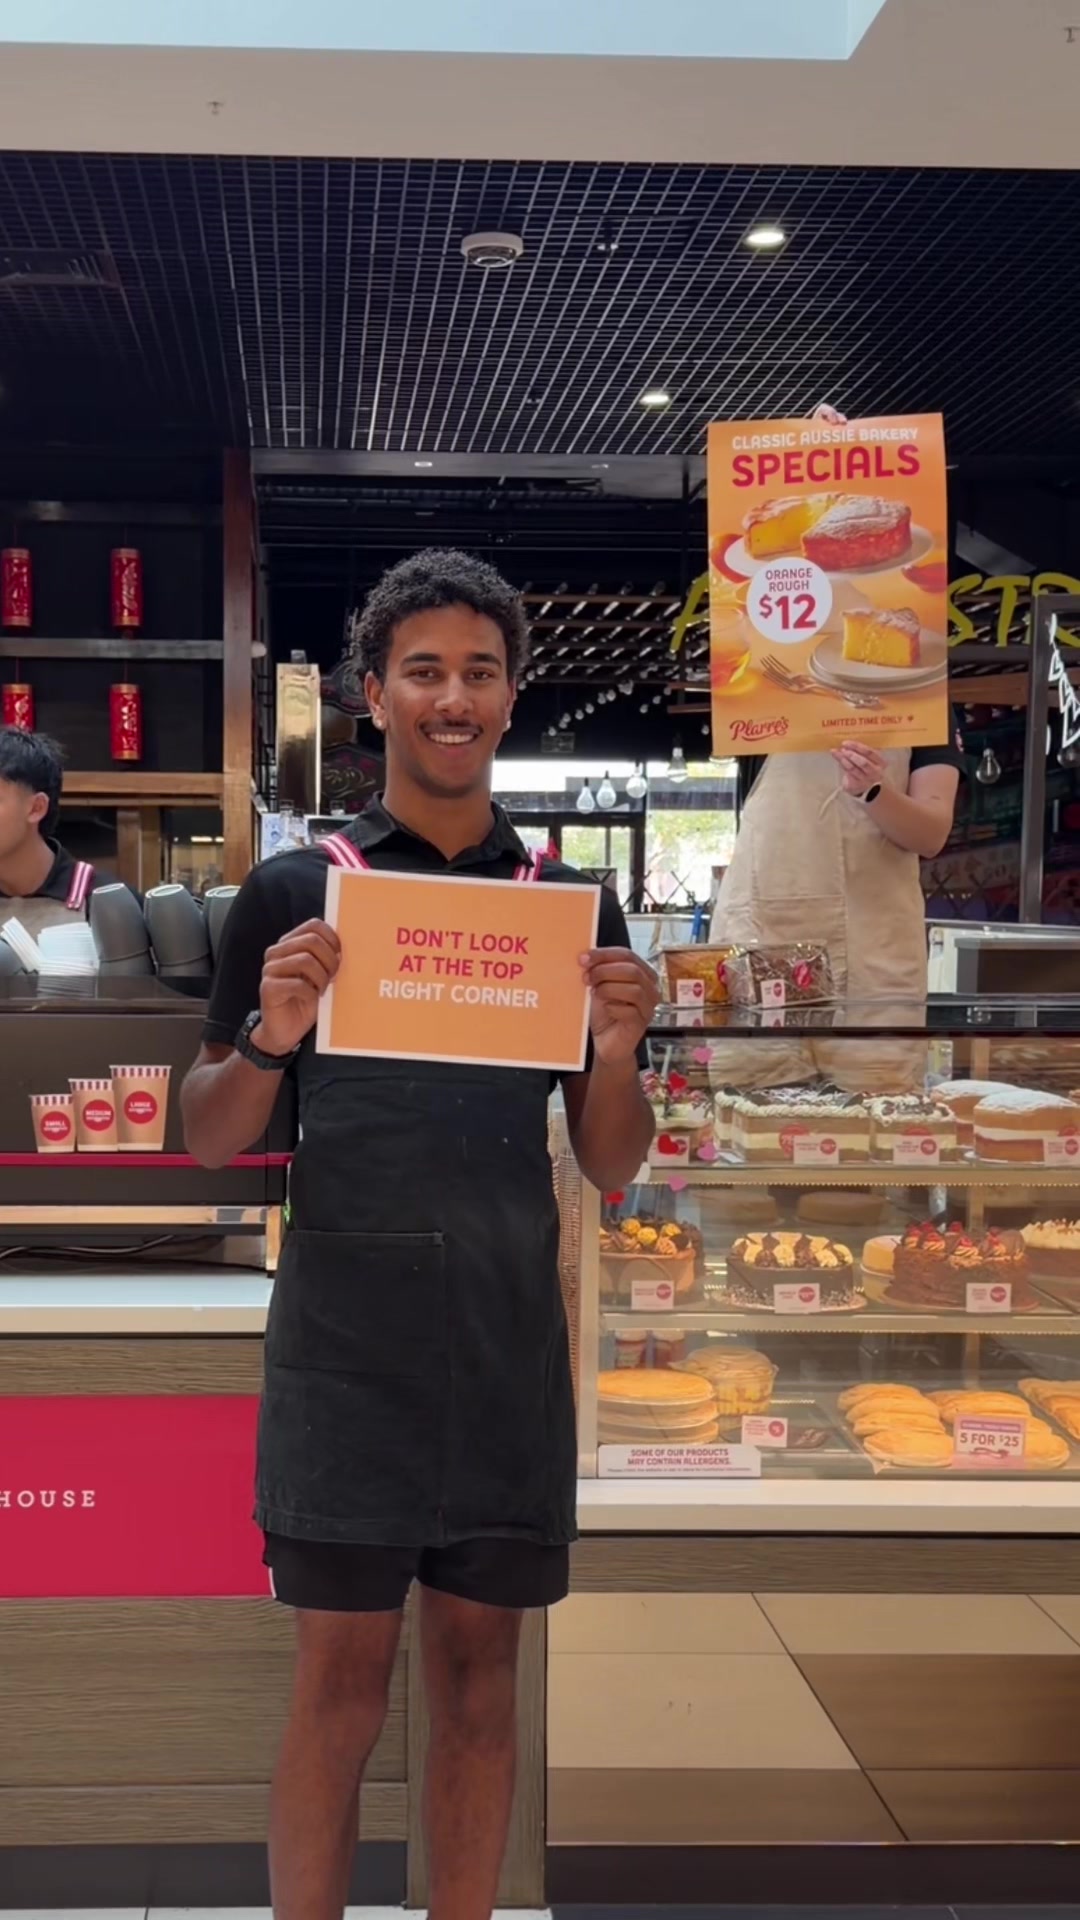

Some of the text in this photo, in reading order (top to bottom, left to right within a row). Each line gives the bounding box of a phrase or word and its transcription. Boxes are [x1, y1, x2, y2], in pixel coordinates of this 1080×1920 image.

[732, 427, 918, 450] CLASSIC AUSSIE BAKERY
[731, 444, 921, 488] SPECIALS
[765, 567, 813, 581] ORANGE
[768, 580, 810, 592] ROUGH
[759, 593, 817, 630] $12
[821, 715, 903, 728] LIMITED TIME ONLY
[396, 927, 529, 955] DON'T LOOK
[399, 954, 523, 980] AT THE TOP
[378, 979, 539, 1008] RIGHT CORNER
[960, 1432, 1020, 1447] 5 FOR $25
[627, 1458, 645, 1466] MAY
[646, 1458, 682, 1466] CONTAIN
[631, 1448, 729, 1457] SOME OF OUR PRODUCTS
[0, 1489, 96, 1508] HOUSE
